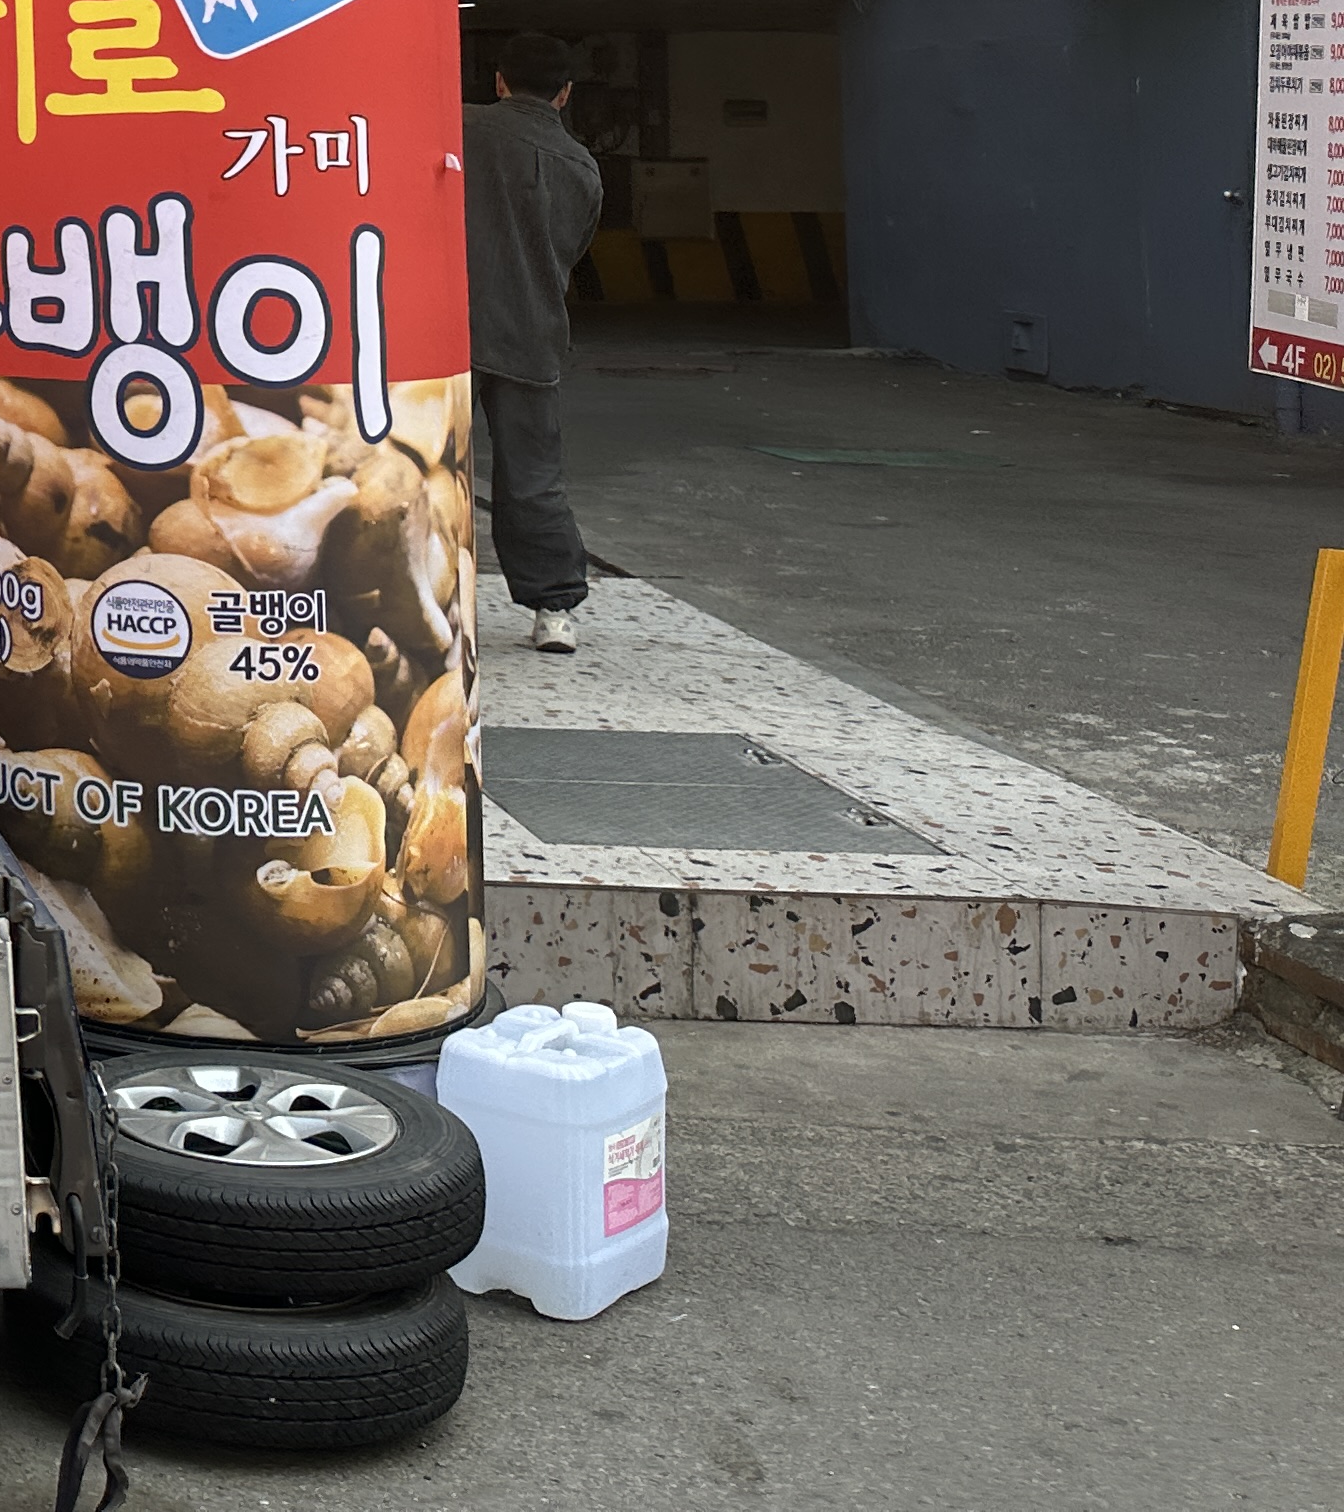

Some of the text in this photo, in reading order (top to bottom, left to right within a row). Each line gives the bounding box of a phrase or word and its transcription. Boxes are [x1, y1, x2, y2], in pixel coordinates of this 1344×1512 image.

[222, 114, 371, 198] 가미
[1281, 343, 1306, 376] 4F
[205, 589, 328, 634] 골뱅이
[107, 613, 320, 682] HACCP 45%
[75, 775, 144, 828] OF
[157, 785, 335, 837] KOREA
